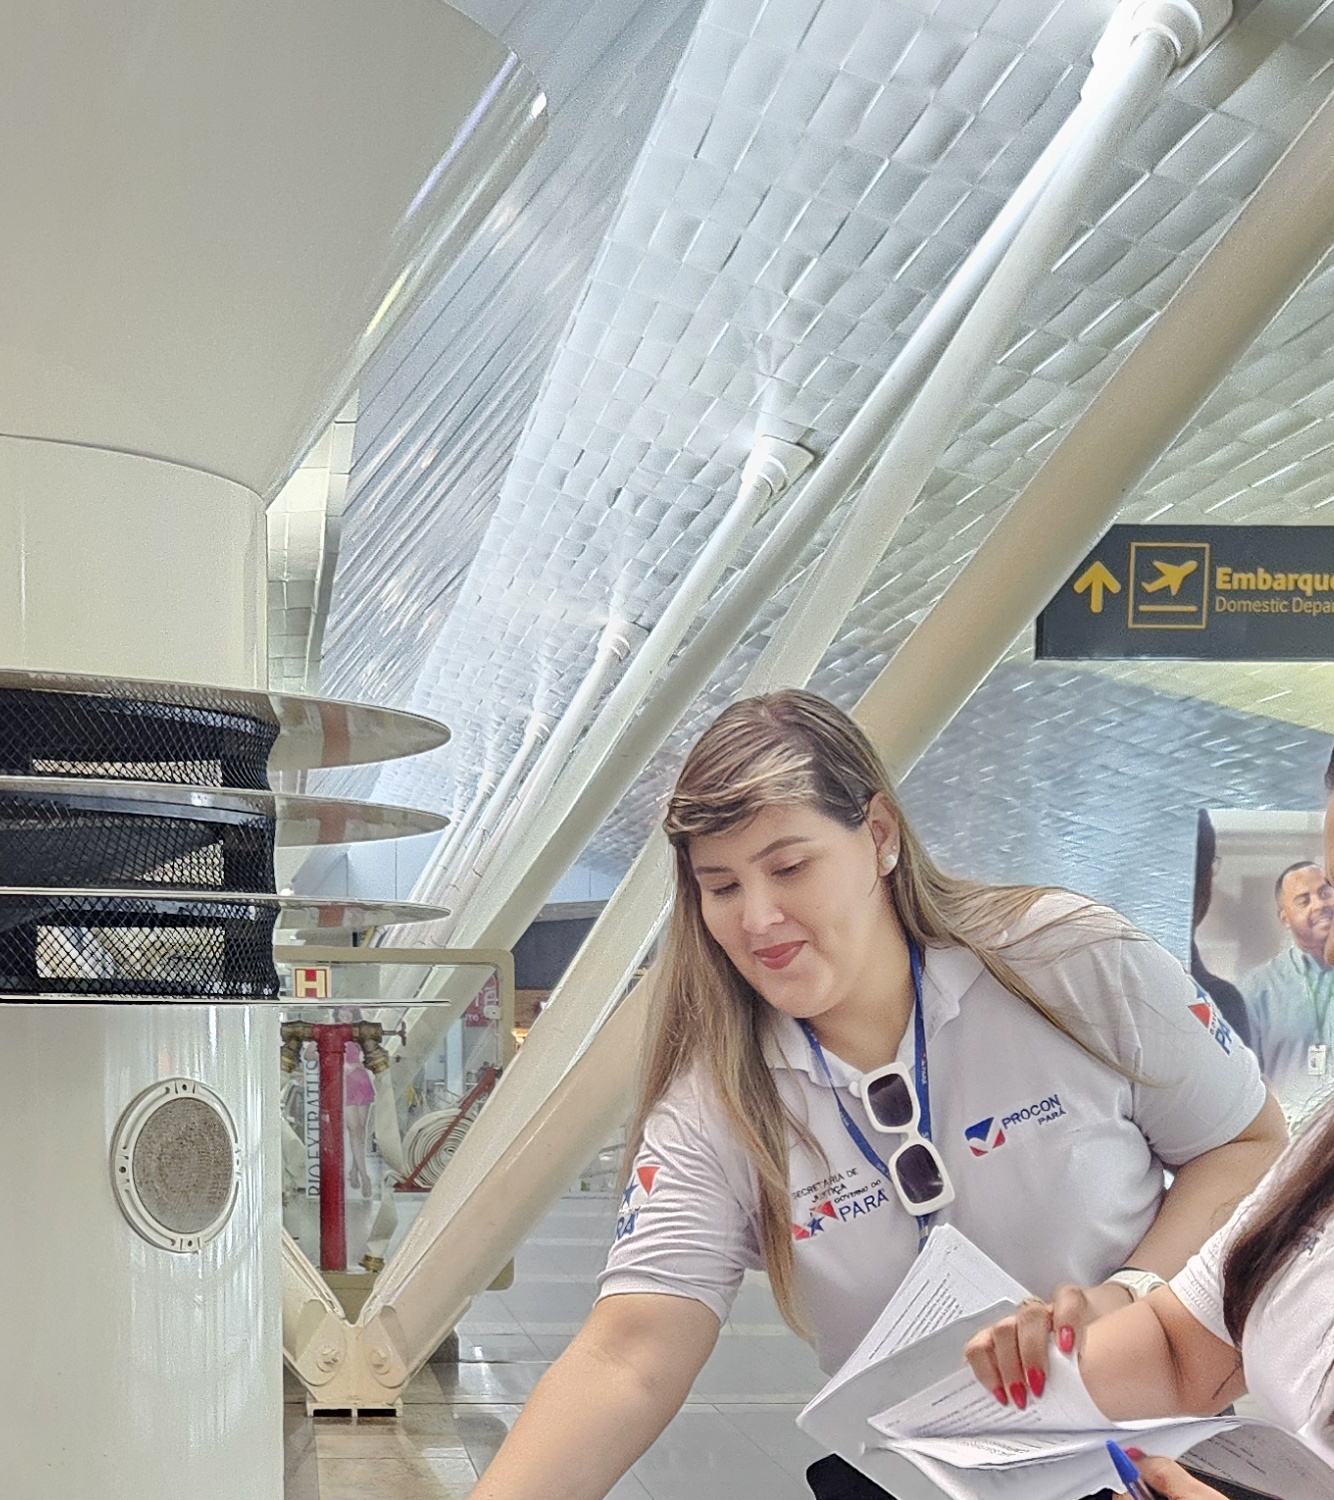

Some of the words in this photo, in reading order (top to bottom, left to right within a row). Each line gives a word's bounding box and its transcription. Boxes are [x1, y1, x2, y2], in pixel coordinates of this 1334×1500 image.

[1215, 596, 1289, 613] Domestic
[296, 969, 327, 997] H
[1001, 1094, 1061, 1130] PROCON
[846, 1168, 858, 1178] DE
